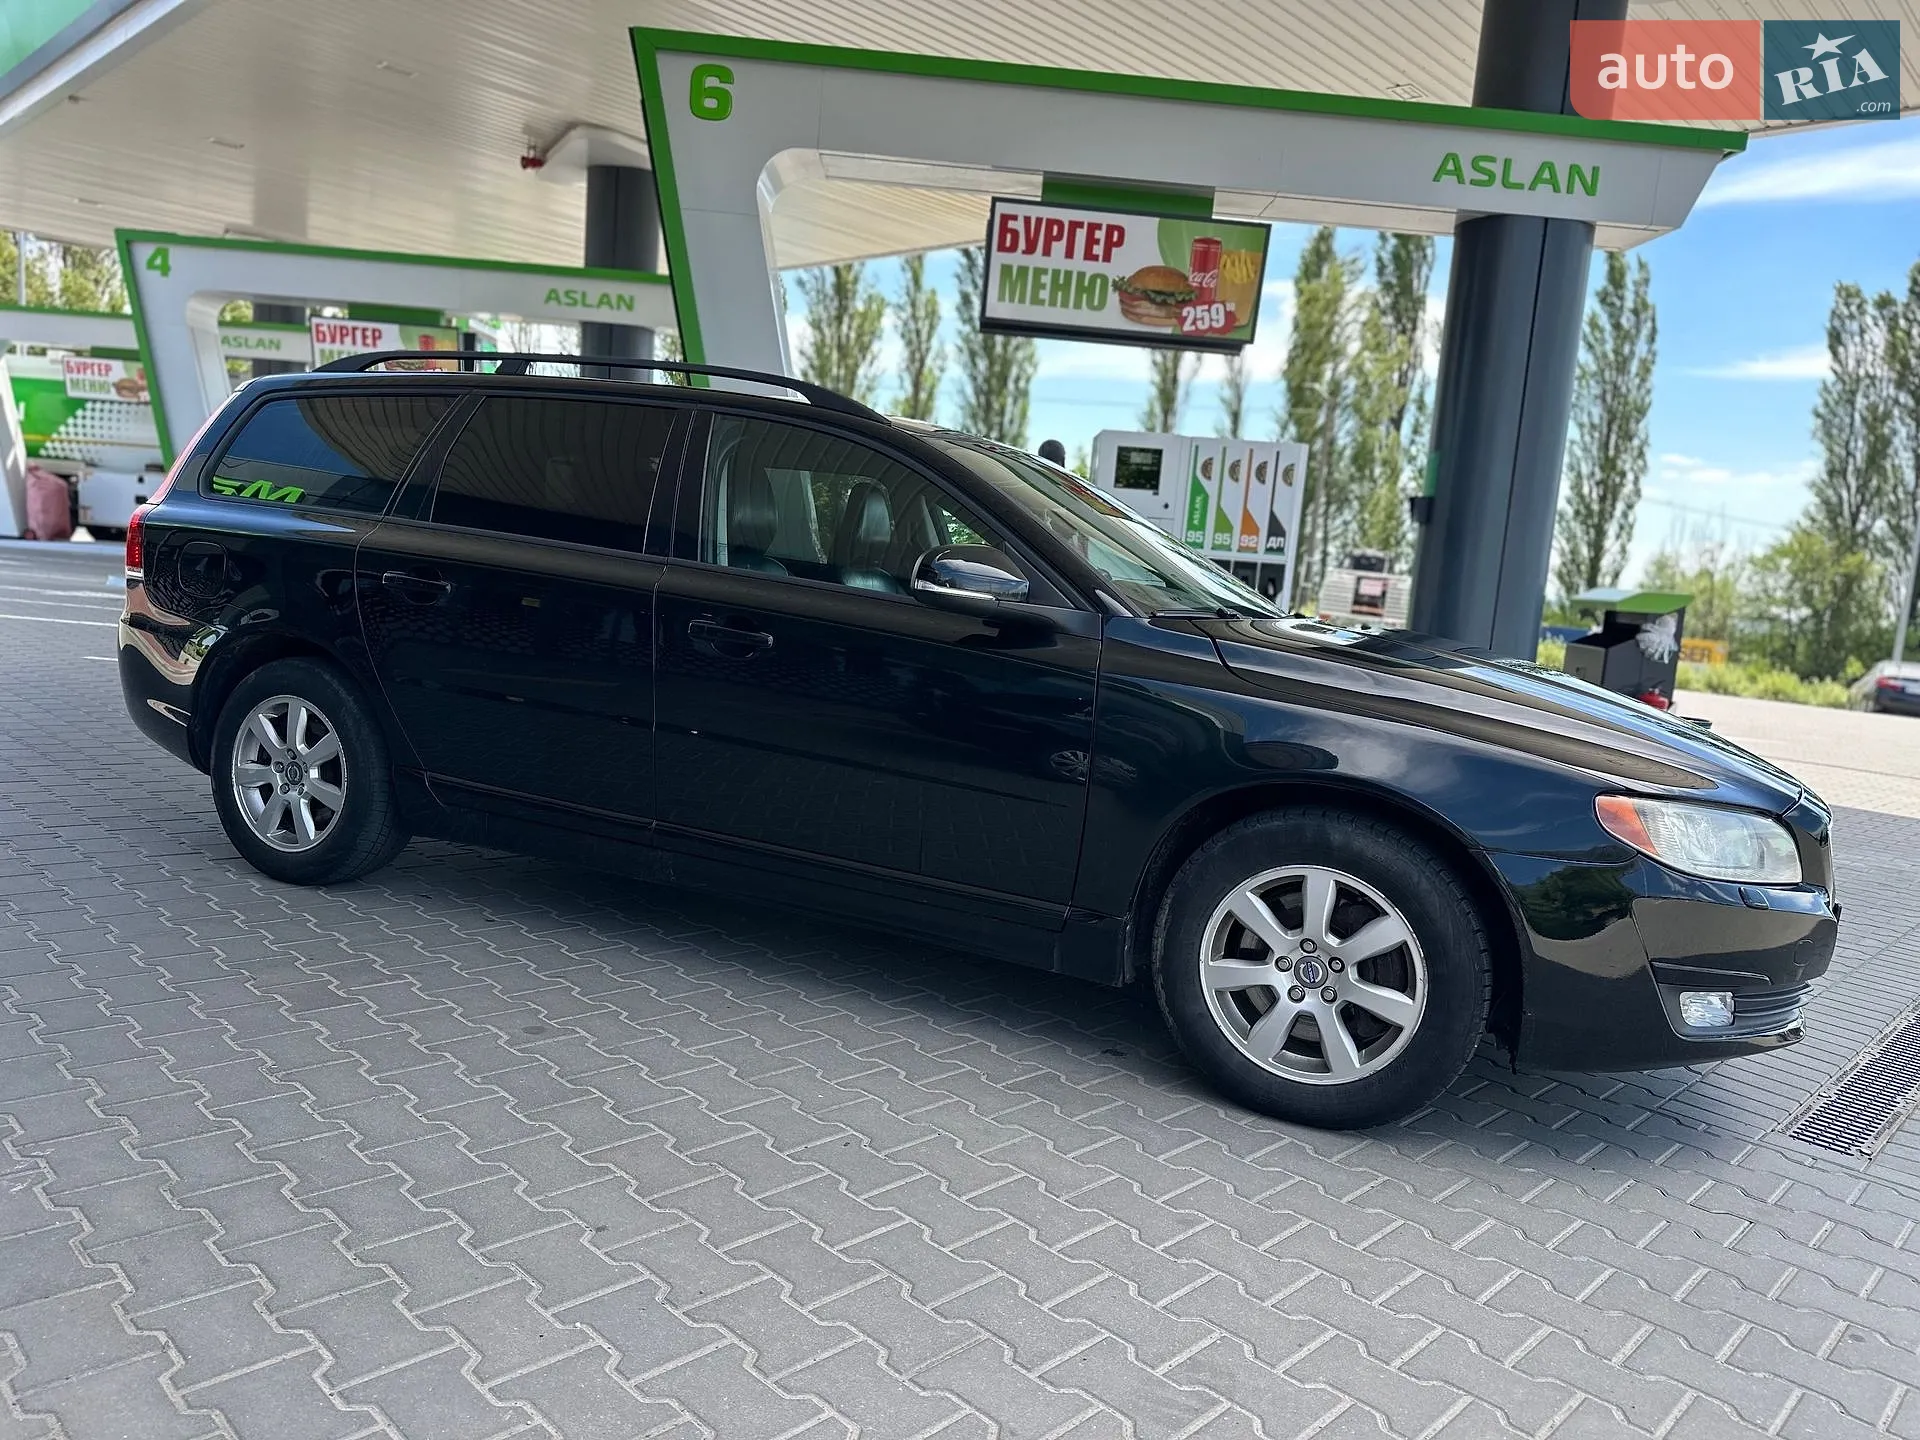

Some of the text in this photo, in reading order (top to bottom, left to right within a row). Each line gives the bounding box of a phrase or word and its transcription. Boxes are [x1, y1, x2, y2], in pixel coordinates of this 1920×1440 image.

[690, 63, 735, 122] 6
[1432, 152, 1600, 197] ASLAN
[996, 213, 1126, 263] БУРГЕР
[146, 246, 171, 278] 4
[543, 288, 635, 312] ASLAN
[997, 263, 1111, 312] МЕНЮ
[1182, 303, 1225, 332] 259
[220, 335, 282, 352] ASLAN
[314, 322, 383, 349] БУРГЕР
[65, 360, 113, 377] БУРГЕР
[69, 377, 112, 393] МЕНЮ
[1193, 495, 1203, 525] ASLAN
[1186, 531, 1205, 542] 95
[1214, 532, 1231, 545] 95
[1239, 534, 1258, 548] 92
[1266, 536, 1285, 549] ДП
